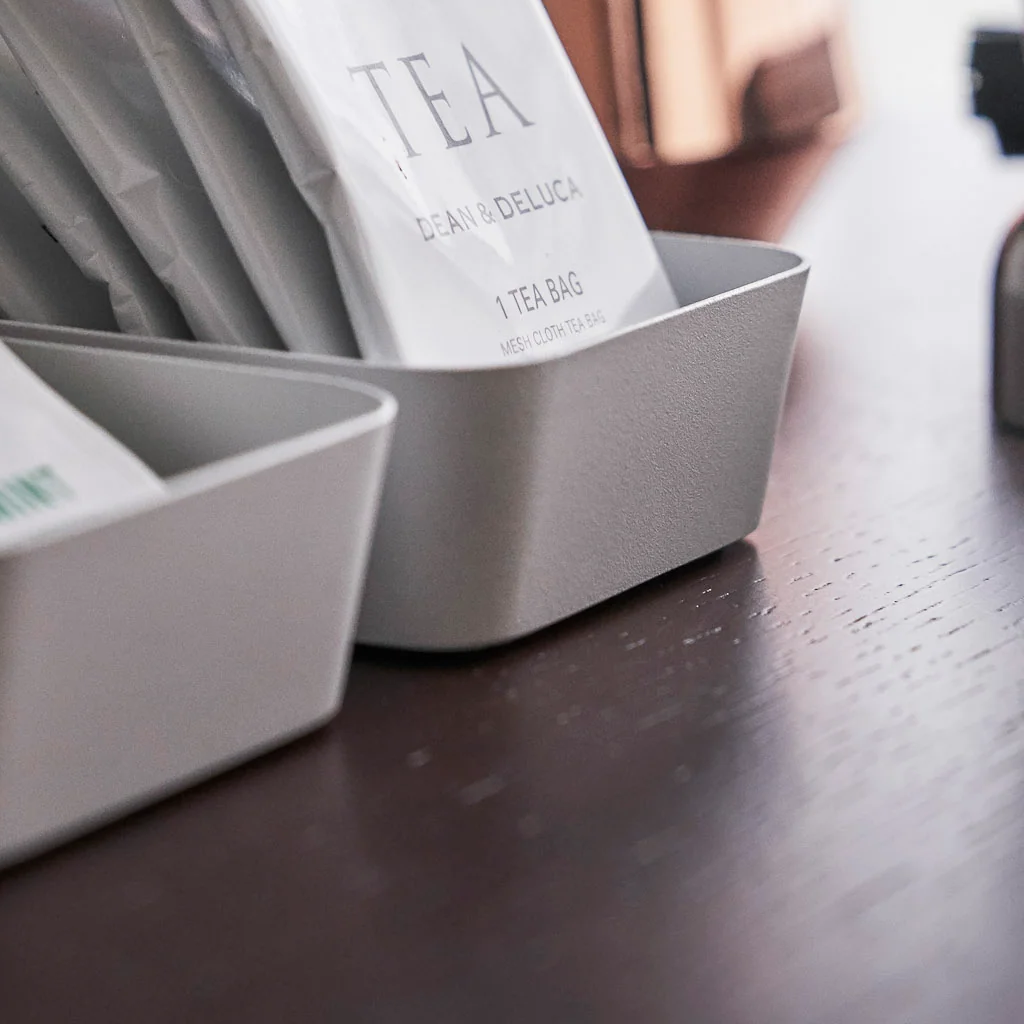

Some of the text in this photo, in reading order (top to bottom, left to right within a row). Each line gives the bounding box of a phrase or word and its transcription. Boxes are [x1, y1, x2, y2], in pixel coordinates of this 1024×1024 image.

[346, 40, 536, 158] TEA
[416, 176, 584, 242] DEAN & DELUCA
[495, 271, 584, 320] 1 TEA BAG
[500, 309, 607, 357] MESH CLOTH TEA BAG
